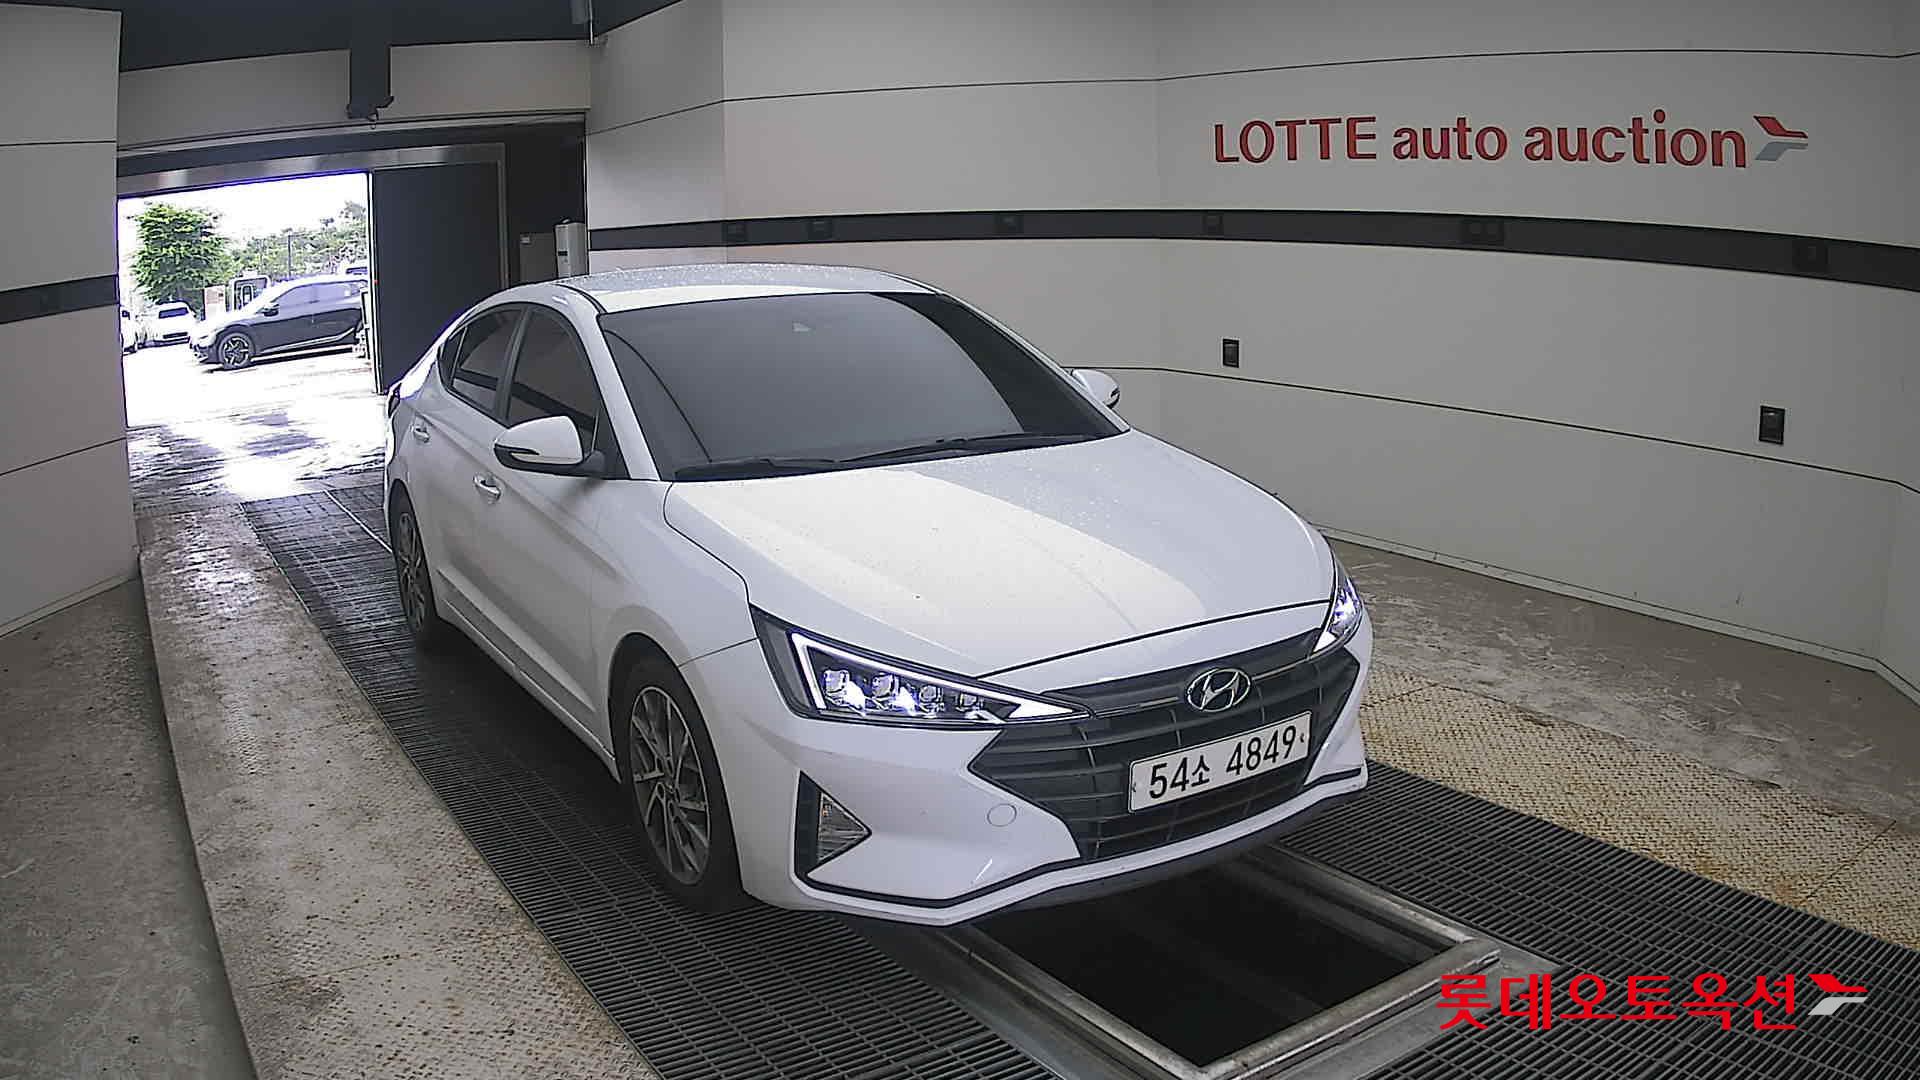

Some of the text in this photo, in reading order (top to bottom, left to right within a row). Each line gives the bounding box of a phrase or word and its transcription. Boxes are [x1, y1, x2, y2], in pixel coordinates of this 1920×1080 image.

[1213, 108, 1748, 168] LOTTE auto auction
[1149, 725, 1297, 799] 54소 4849
